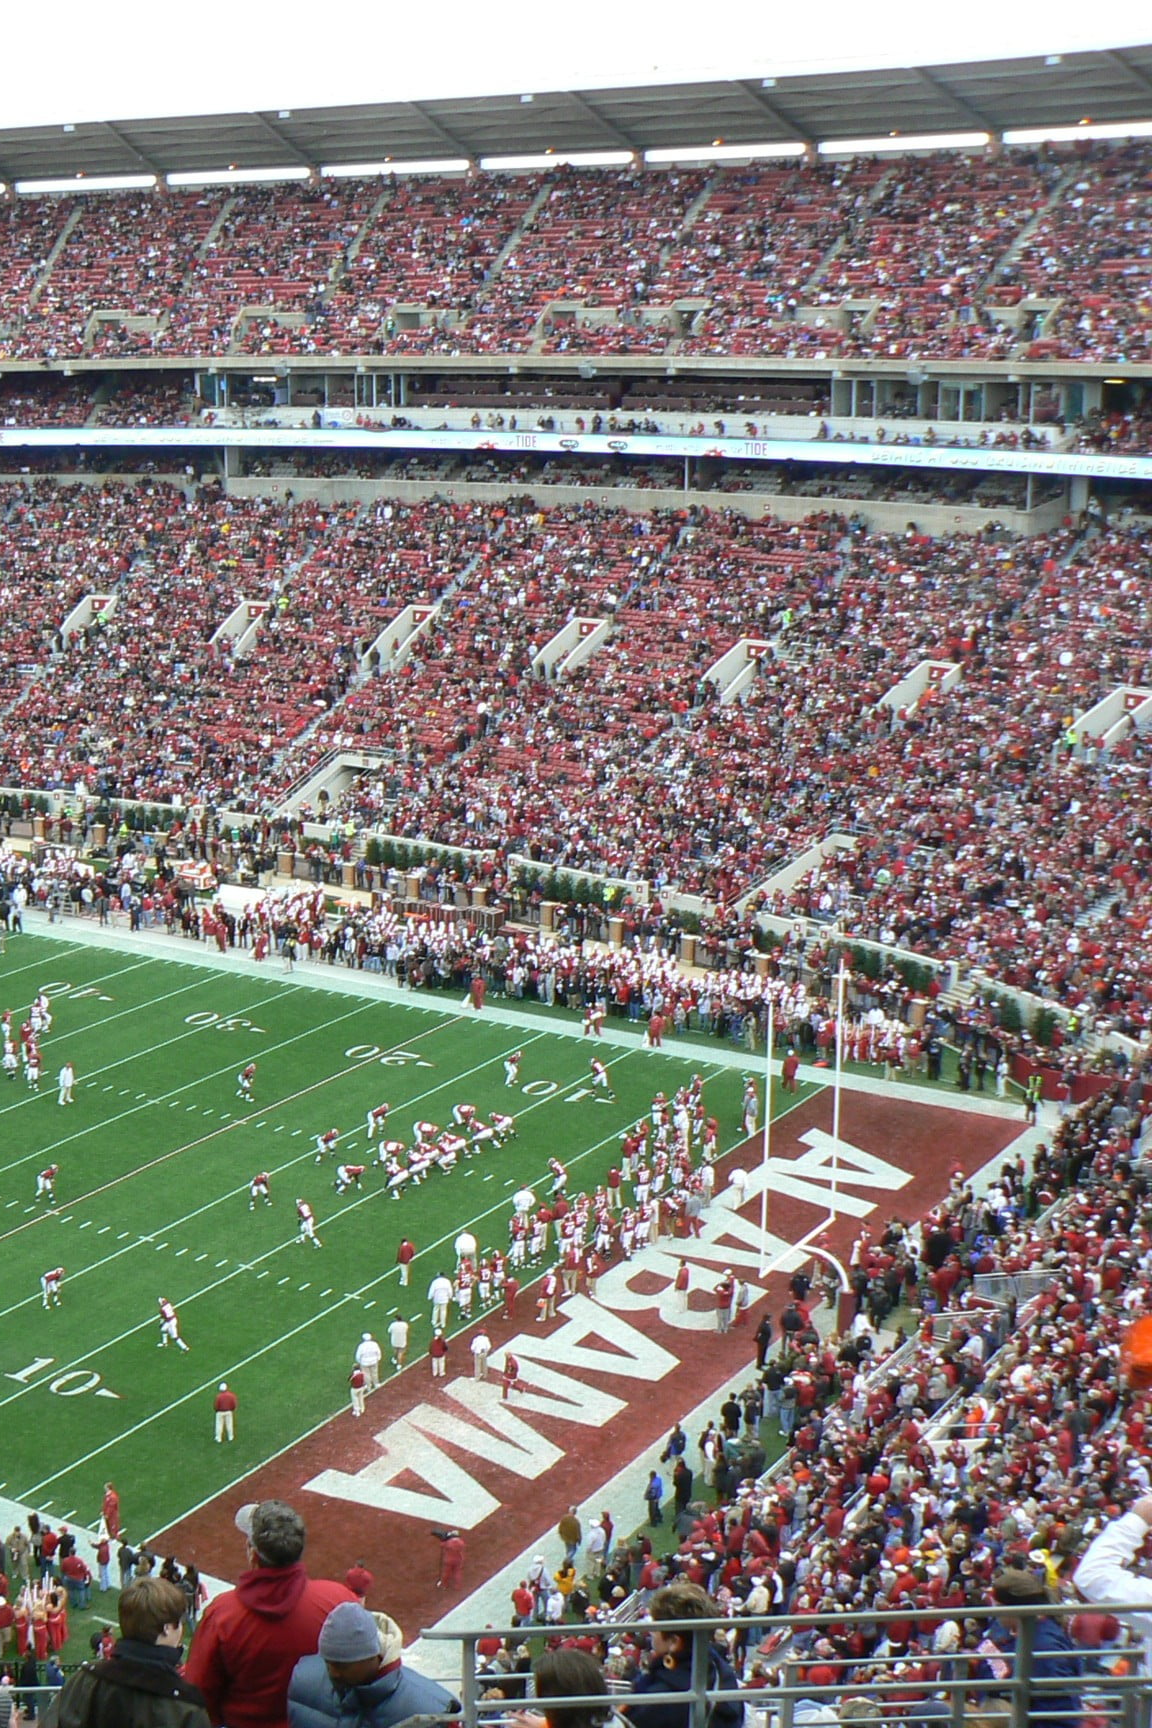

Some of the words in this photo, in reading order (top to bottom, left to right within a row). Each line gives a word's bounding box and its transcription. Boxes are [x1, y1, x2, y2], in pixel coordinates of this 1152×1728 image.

[515, 435, 537, 448] TIDE
[744, 442, 768, 456] TIDE
[184, 1011, 252, 1032] 30
[345, 1044, 421, 1066] 20
[521, 1080, 593, 1103] 10
[302, 1127, 915, 1531] ALABAMA
[4, 1356, 102, 1397] 10
